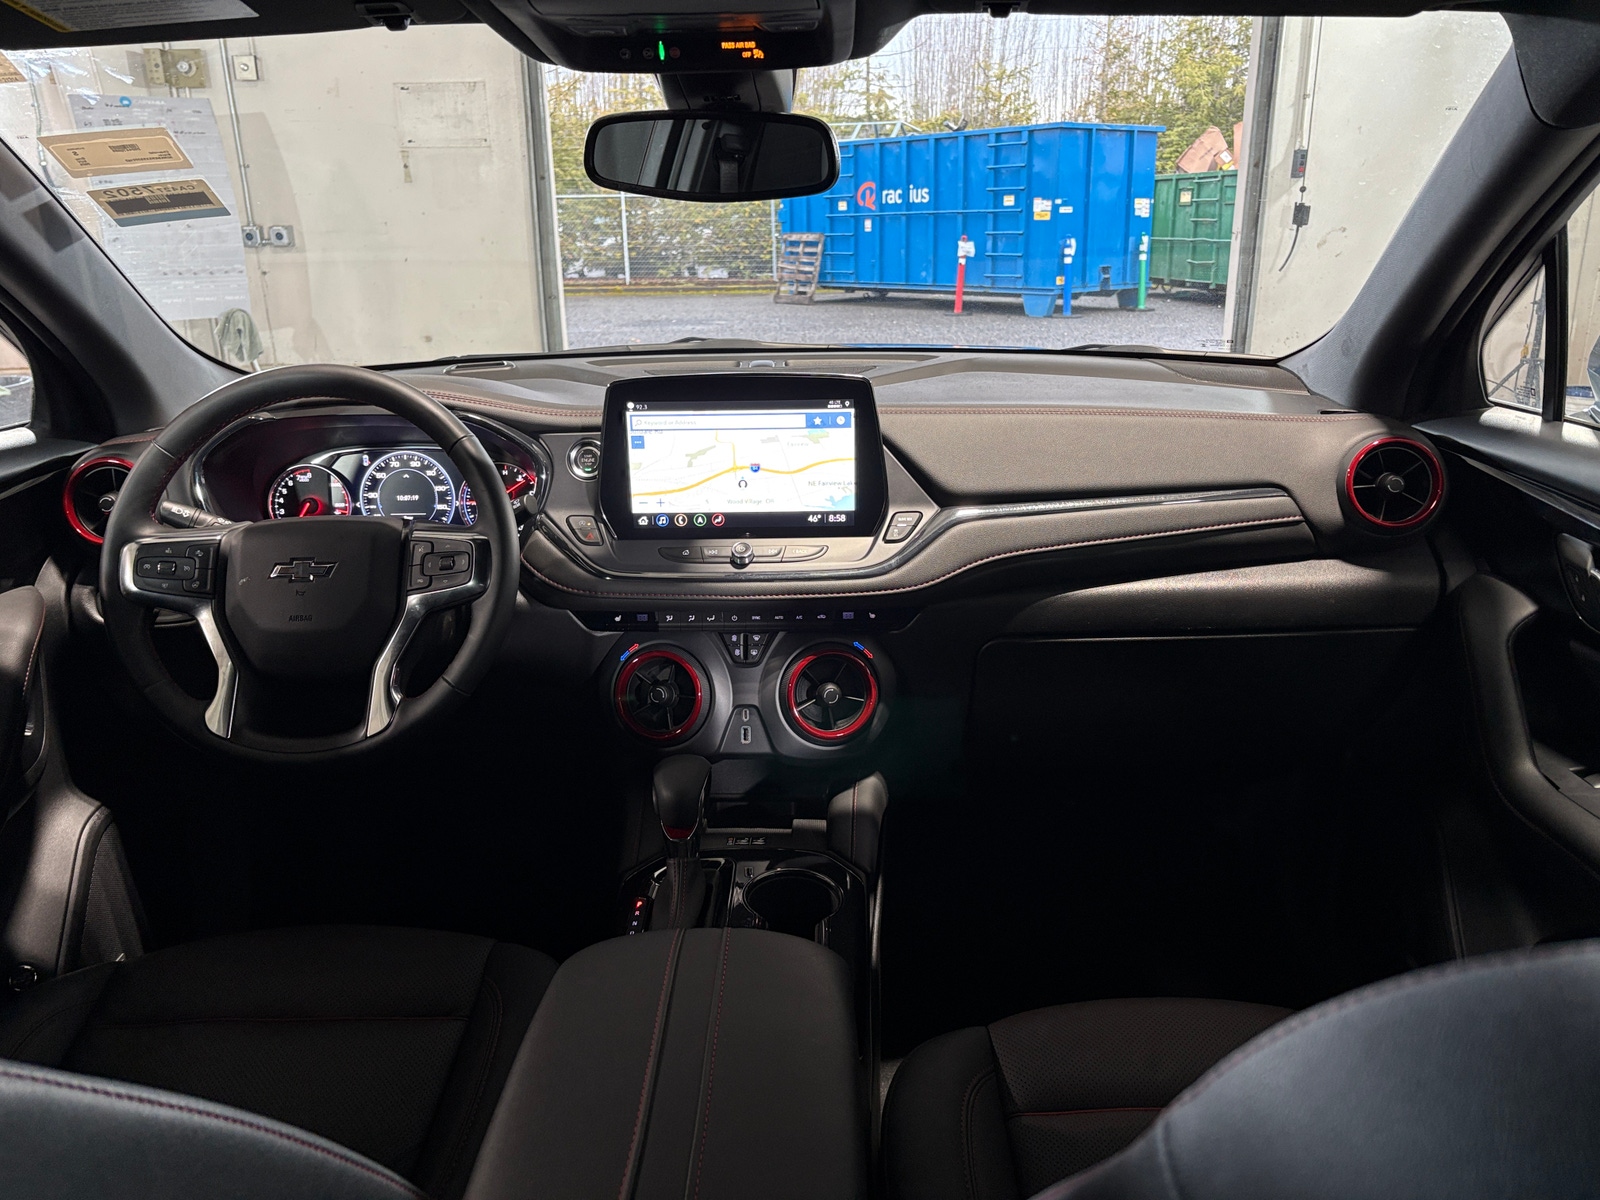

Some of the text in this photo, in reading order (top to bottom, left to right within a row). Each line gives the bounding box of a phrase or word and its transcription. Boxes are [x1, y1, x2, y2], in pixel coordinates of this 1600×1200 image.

[808, 514, 821, 522] 46°
[828, 514, 846, 522] 8:58
[289, 614, 312, 622] AIRBAG
